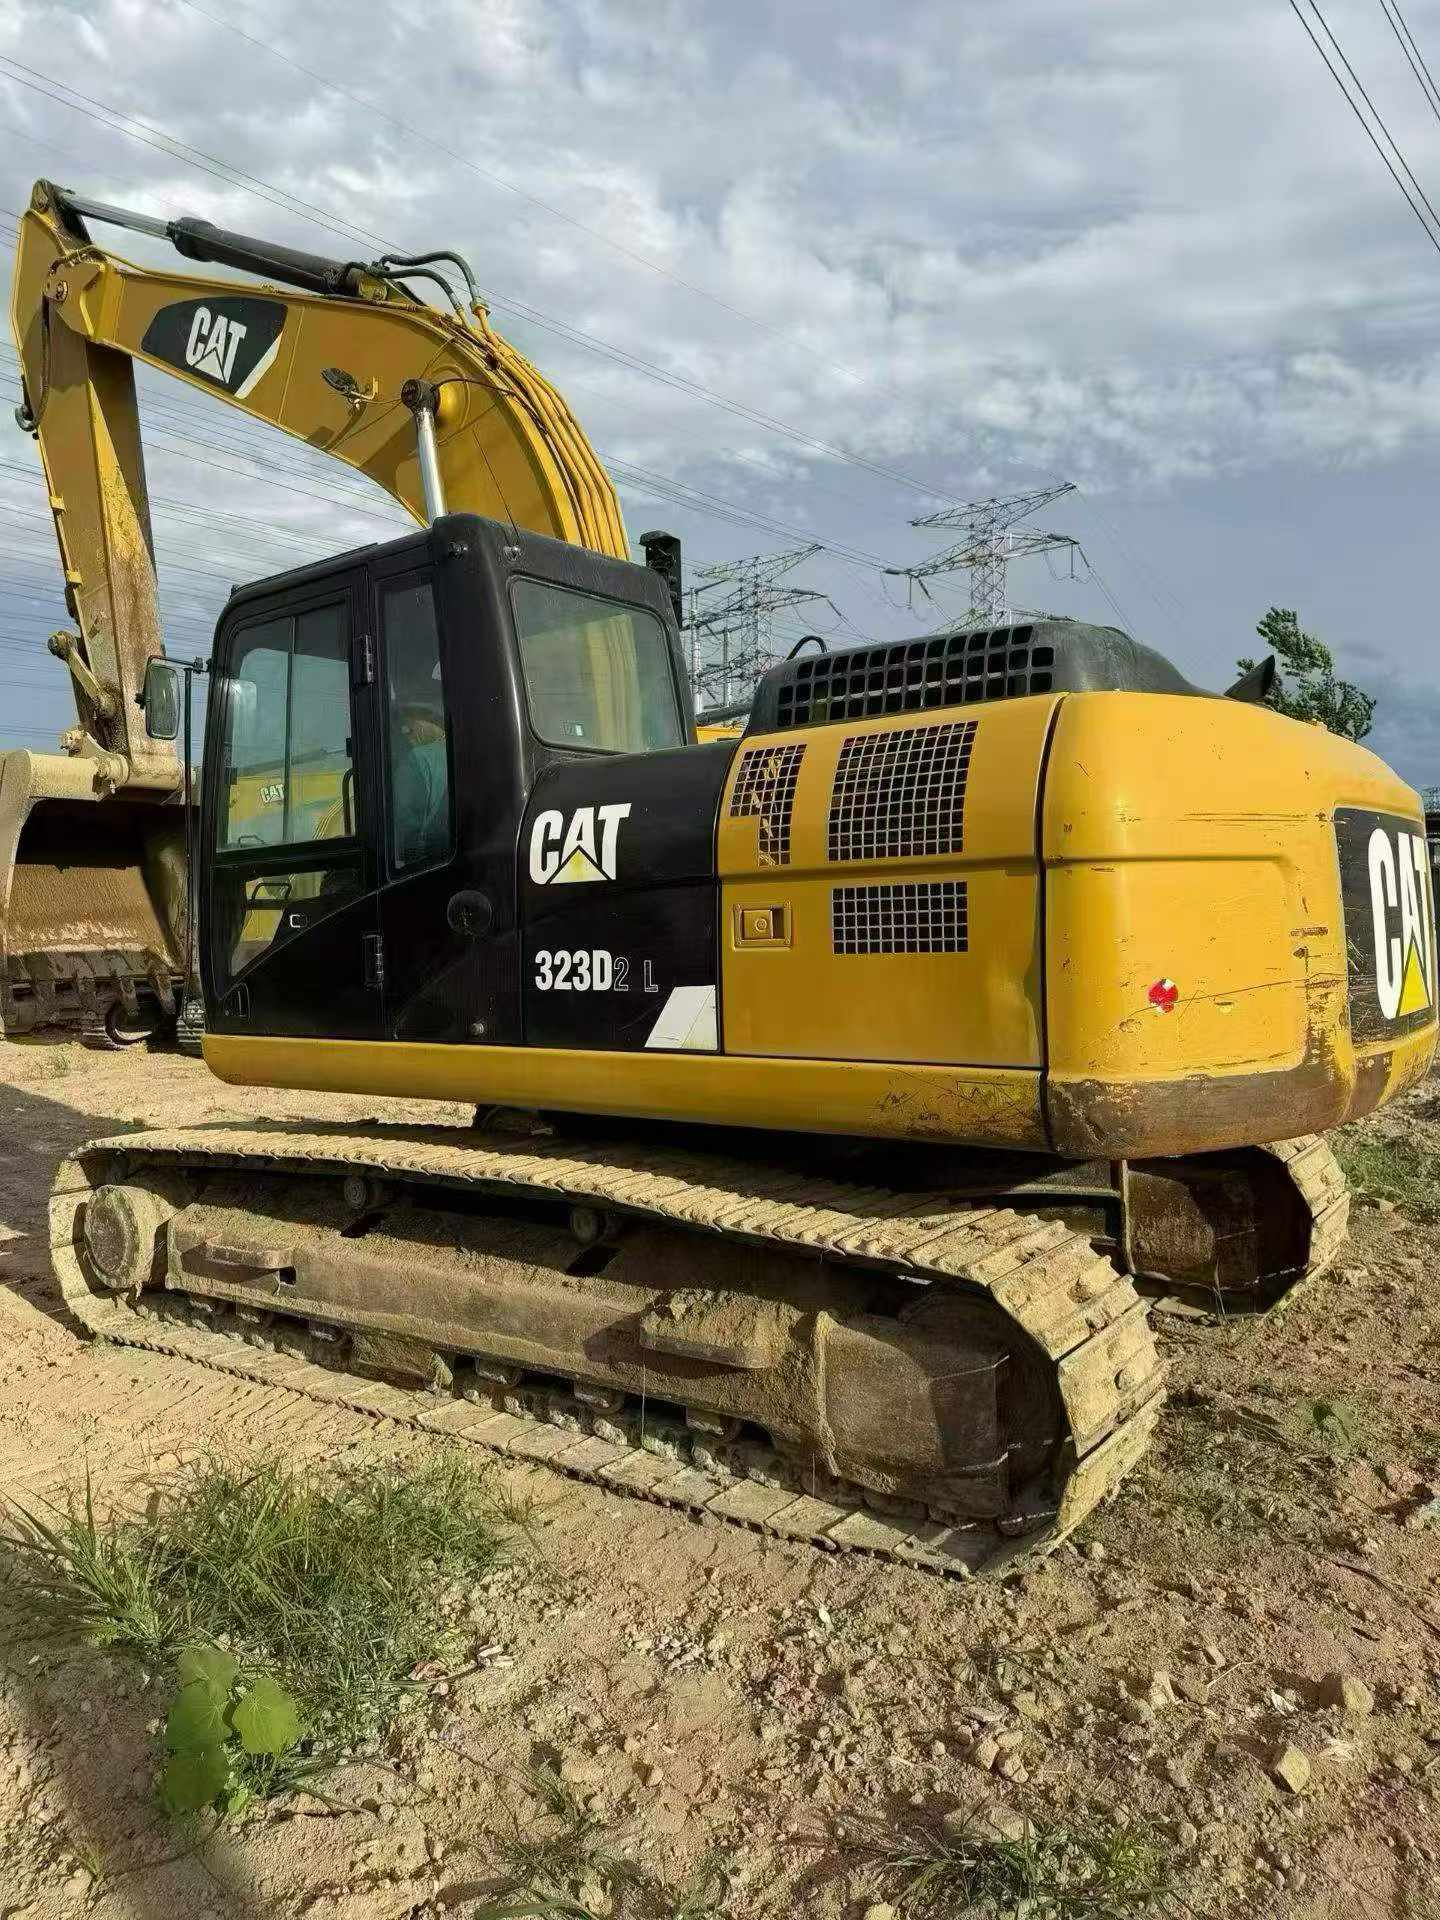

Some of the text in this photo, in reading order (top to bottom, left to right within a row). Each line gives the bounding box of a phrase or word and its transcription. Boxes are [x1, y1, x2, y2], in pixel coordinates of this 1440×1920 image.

[186, 306, 247, 384] CAT
[260, 783, 285, 803] CAT
[529, 803, 632, 885] CAT
[1368, 828, 1433, 1020] CAT
[643, 959, 659, 992] L
